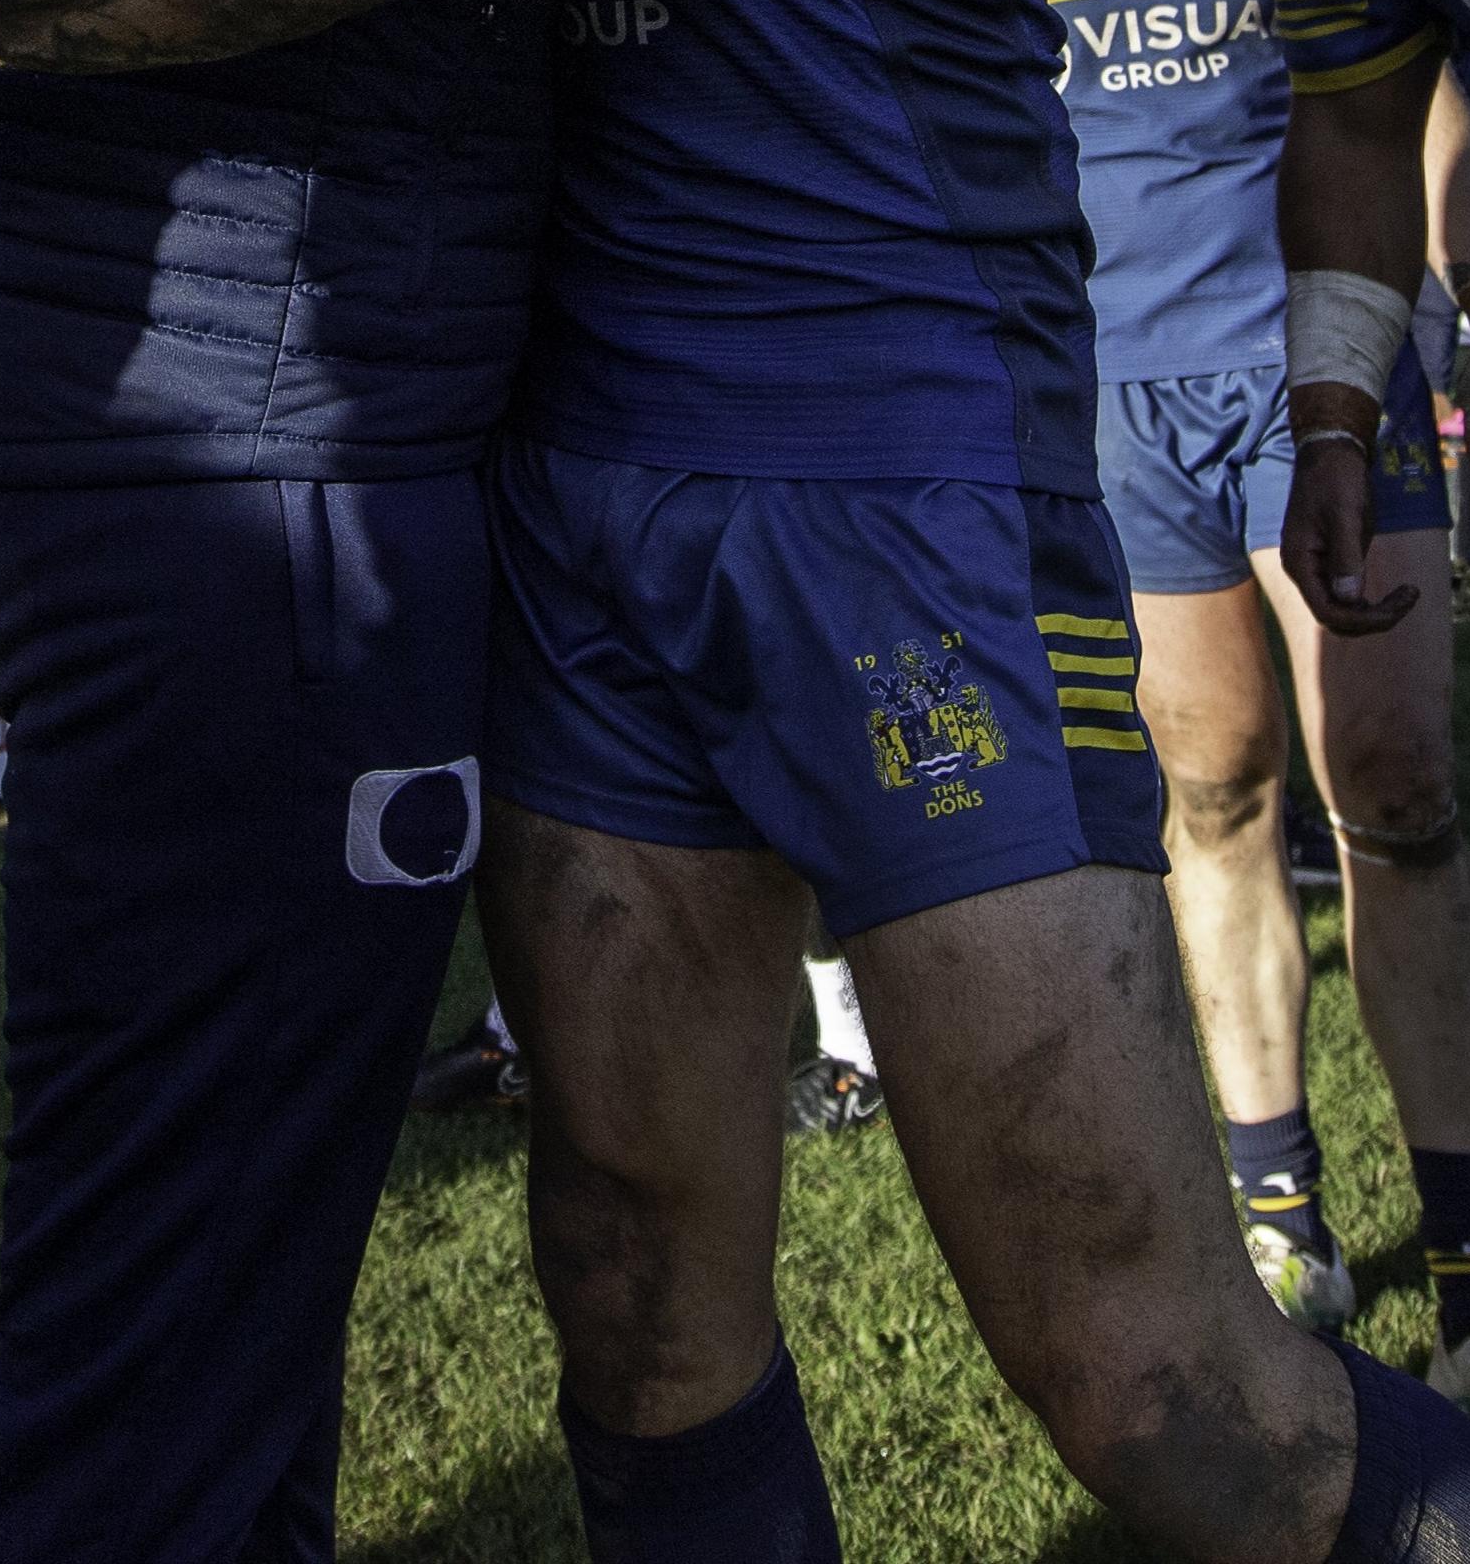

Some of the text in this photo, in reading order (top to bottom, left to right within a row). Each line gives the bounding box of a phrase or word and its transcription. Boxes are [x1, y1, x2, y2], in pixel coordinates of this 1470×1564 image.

[1100, 52, 1230, 92] GROUP
[941, 631, 964, 649] 51
[854, 654, 878, 671] 19
[930, 779, 967, 797] THE
[925, 790, 985, 820] DONS
